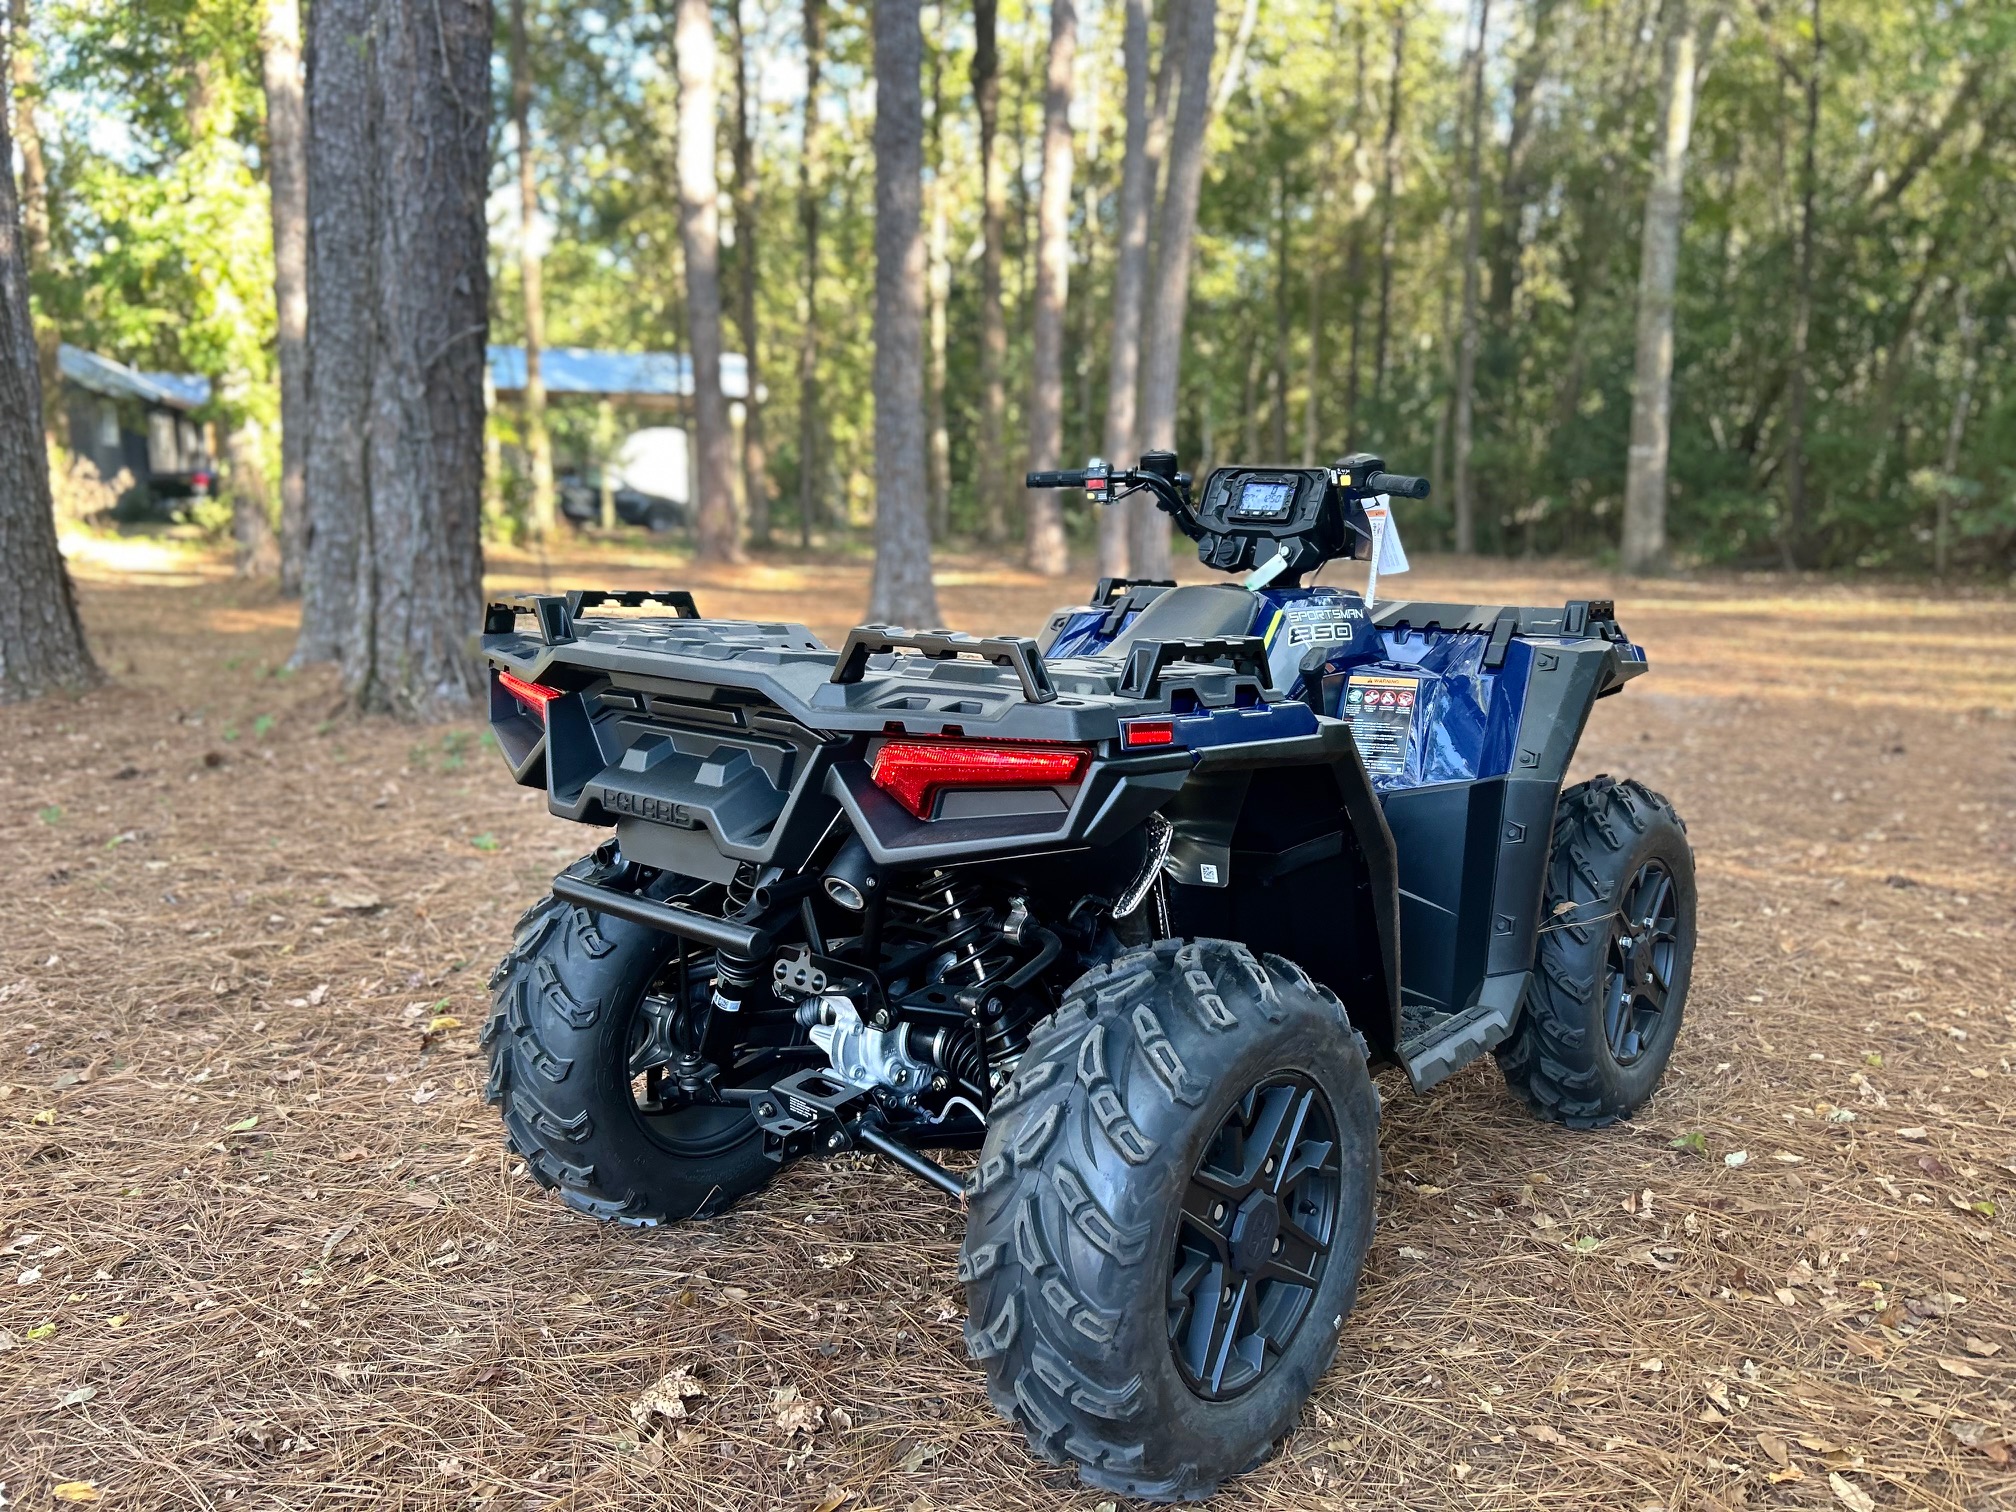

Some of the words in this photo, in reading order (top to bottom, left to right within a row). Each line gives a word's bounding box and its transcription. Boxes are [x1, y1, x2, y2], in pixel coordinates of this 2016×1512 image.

[1288, 608, 1364, 623] SPORTSMAN
[1288, 622, 1353, 647] 850
[603, 788, 690, 826] POLARIS
